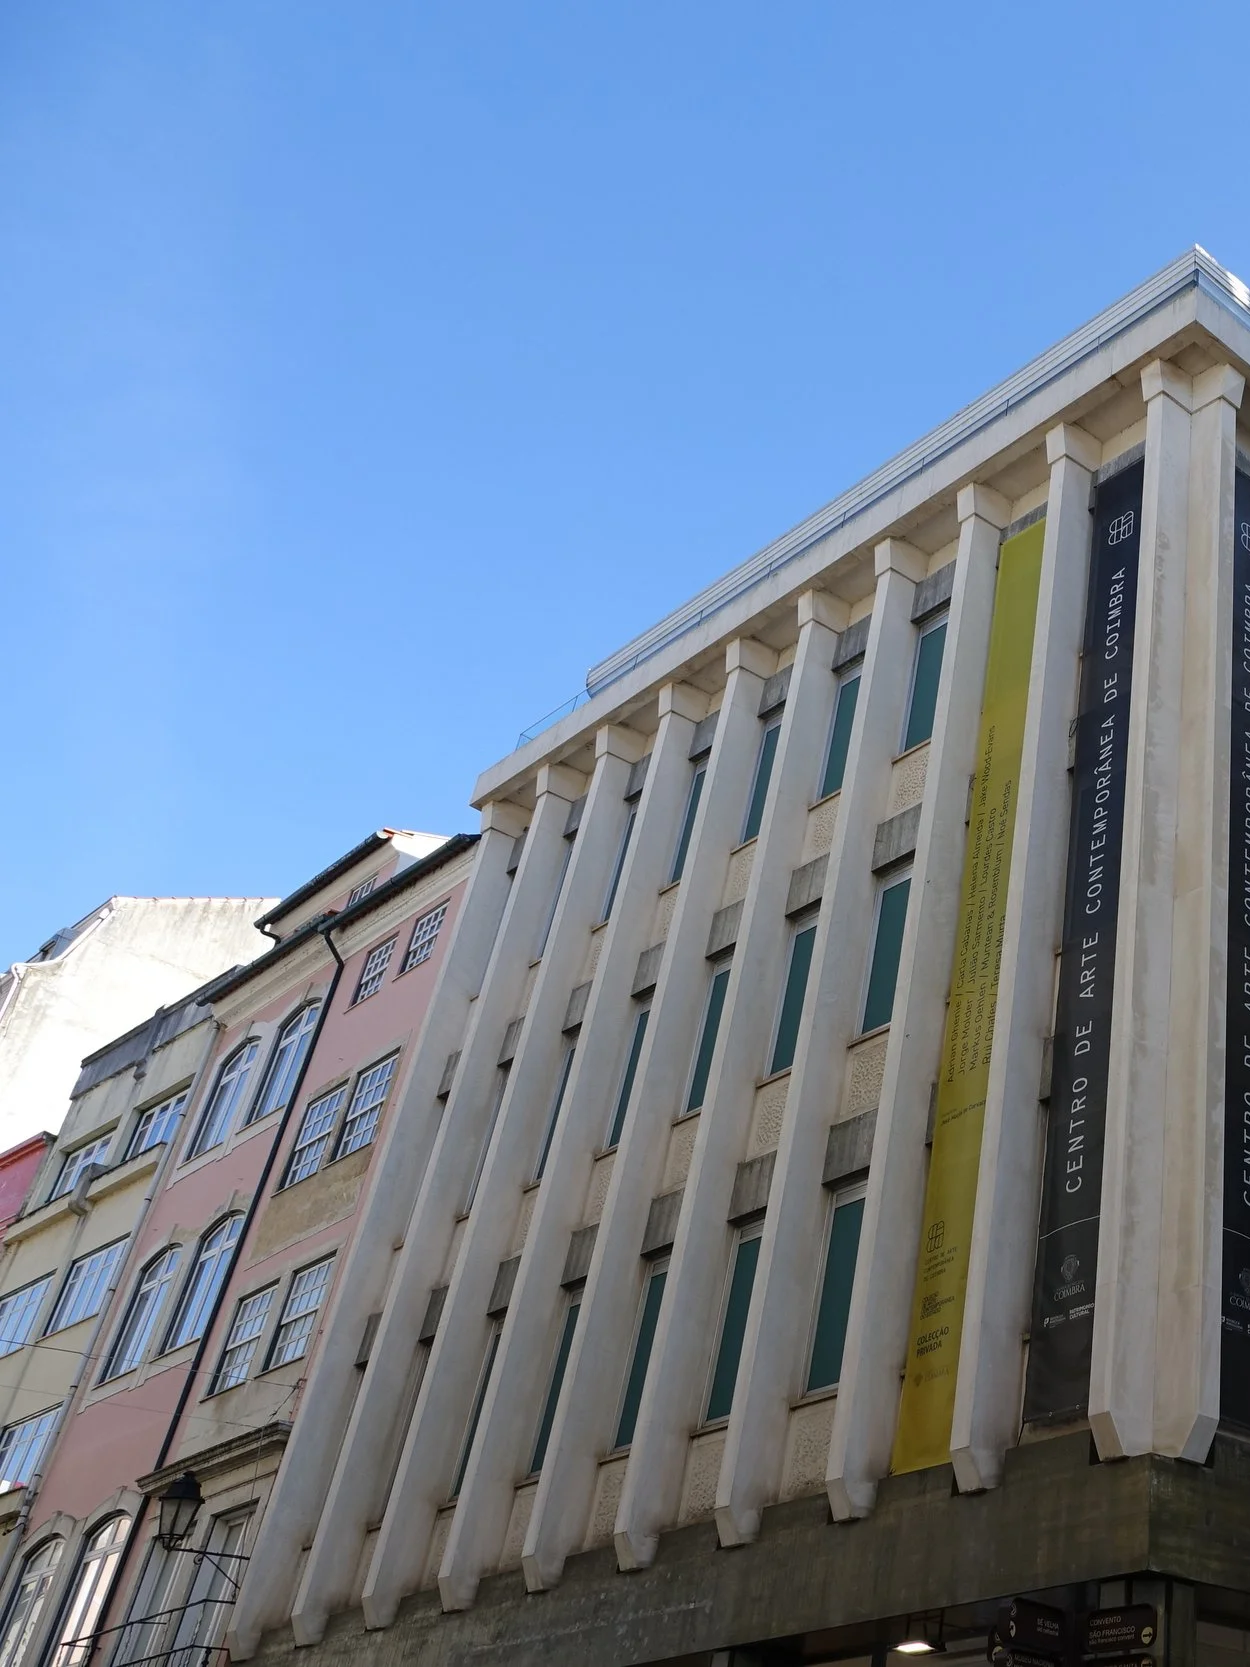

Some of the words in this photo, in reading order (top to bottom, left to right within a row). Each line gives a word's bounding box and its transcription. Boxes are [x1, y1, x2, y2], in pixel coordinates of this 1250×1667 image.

[1105, 566, 1126, 660] COIMBRA
[1103, 672, 1118, 704] DE
[979, 786, 988, 808] Jake
[1000, 780, 1012, 817] Sendas
[1086, 713, 1115, 915] CONTEMPORÂNEA
[972, 819, 984, 859] Almeida
[986, 808, 997, 842] Castro
[968, 862, 979, 899] Helena
[980, 843, 993, 885] Lourdes
[989, 849, 1004, 908] Rosenblum
[960, 909, 973, 956] Cabanas
[972, 896, 986, 949] Sarmento
[981, 922, 994, 969] Muntean
[1079, 931, 1099, 998] ARTE
[956, 958, 967, 989] Carla
[962, 1000, 973, 1038] Molder
[974, 982, 986, 1022] Oehlen
[969, 1025, 982, 1070] Markus
[1074, 1020, 1093, 1057] DE
[946, 1044, 957, 1083] Adrian
[959, 1041, 969, 1075] Jorge
[1066, 1077, 1088, 1193] CENTRO
[1054, 1283, 1085, 1302] COIMBRA
[916, 1340, 942, 1358] PRIVADA
[917, 1326, 950, 1346] COLECÇÃO
[1089, 1616, 1121, 1626] CONVENTO
[1089, 1630, 1101, 1639] SÃO
[1102, 1625, 1136, 1637] FRANCISCO
